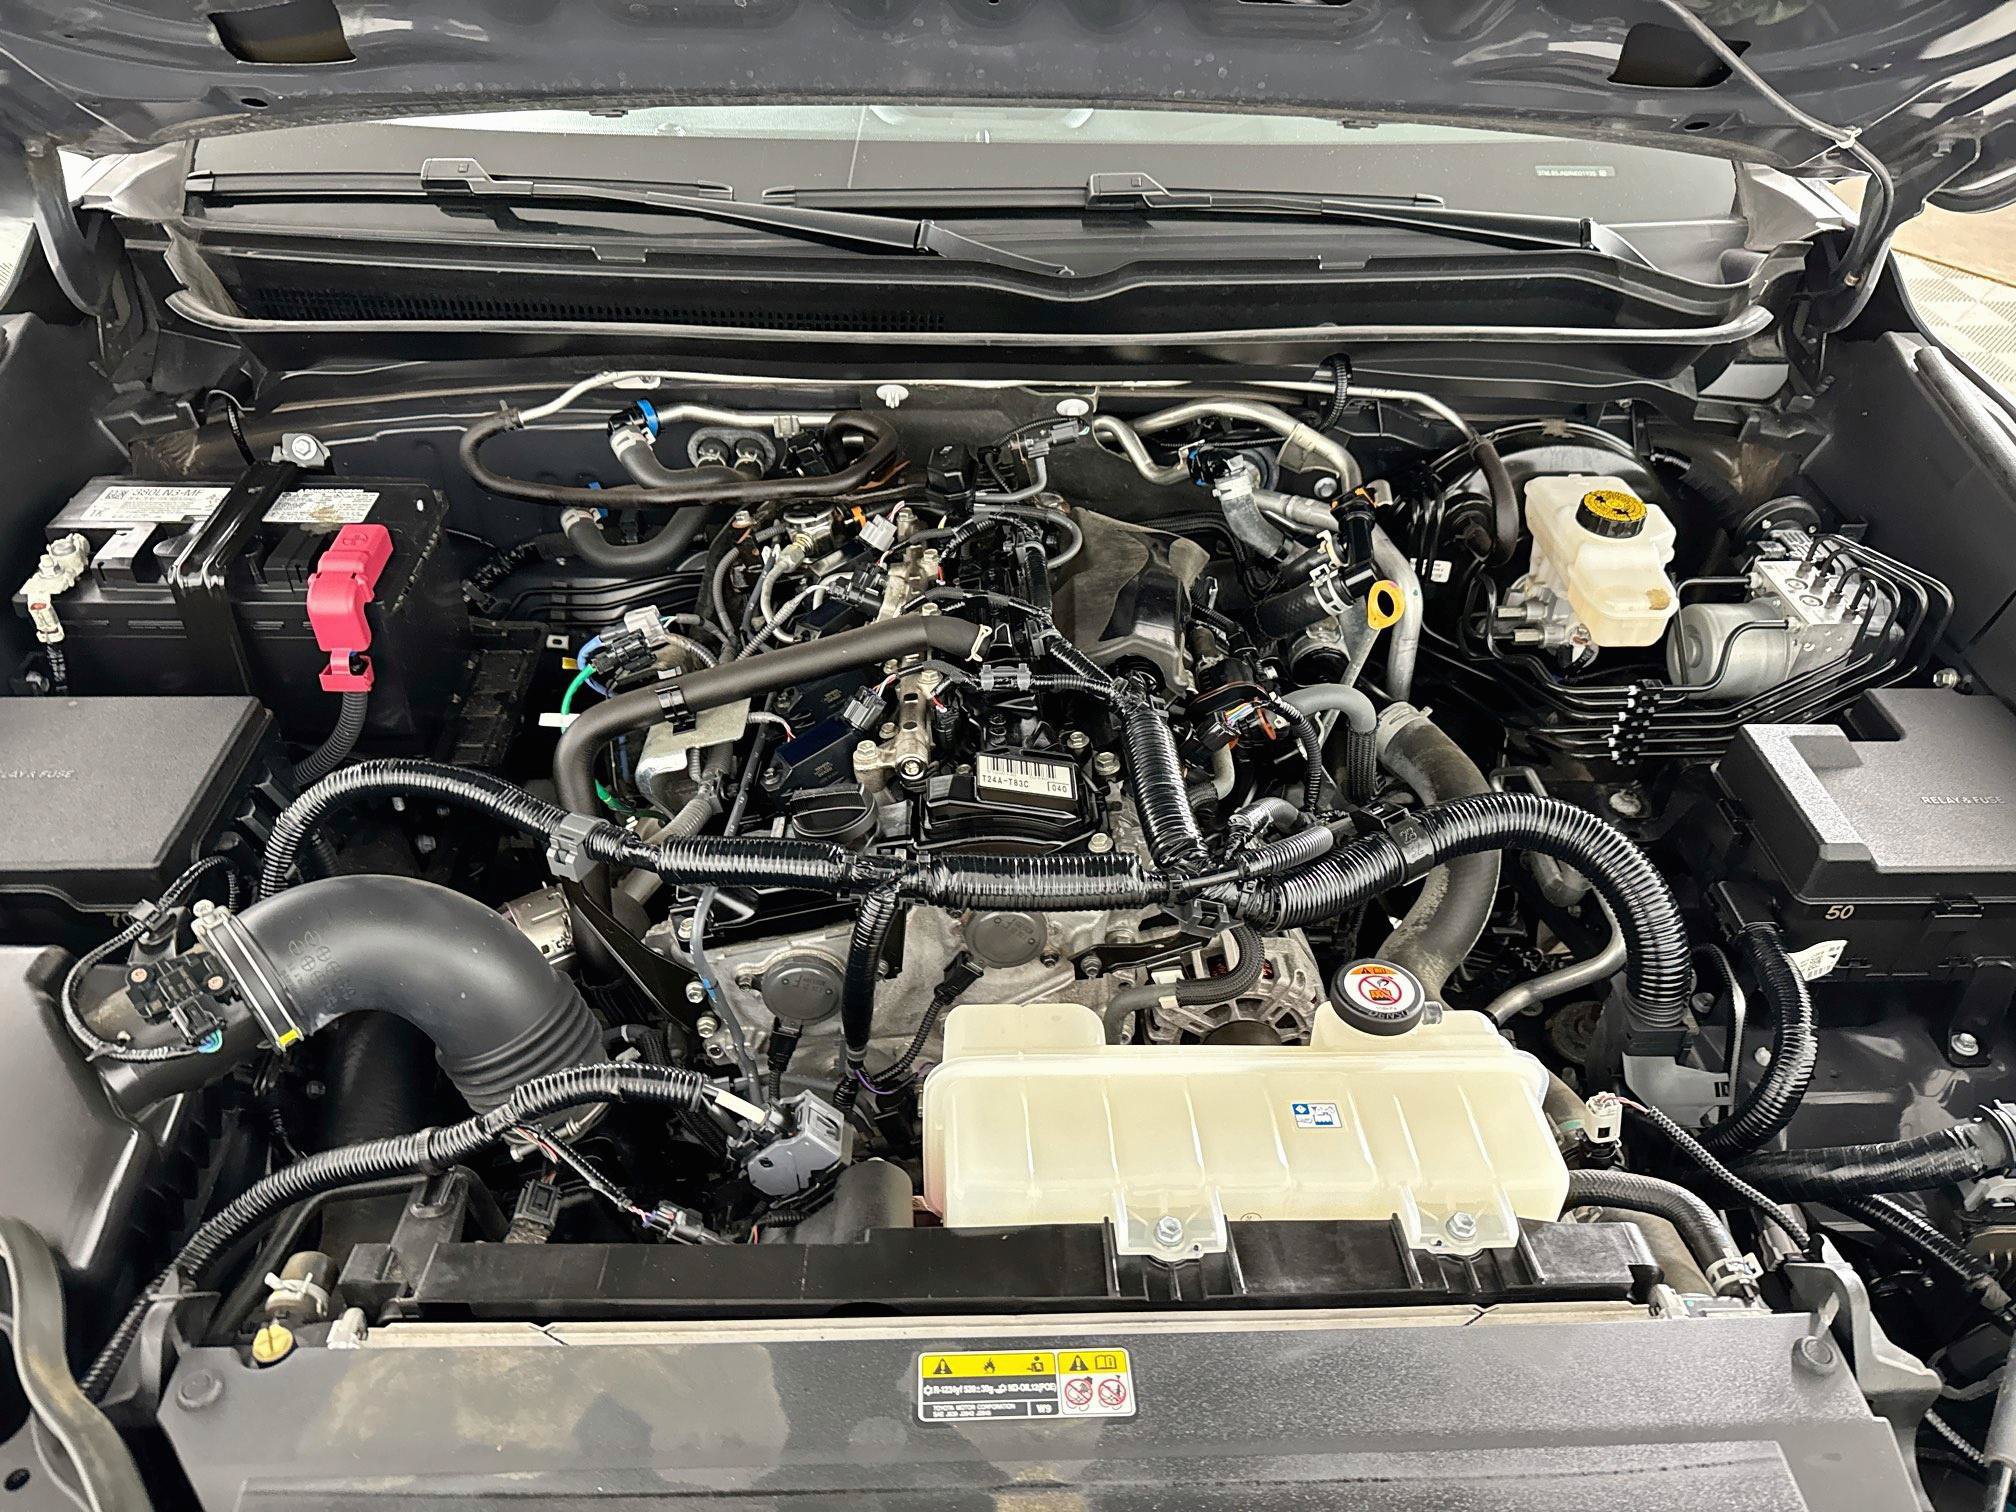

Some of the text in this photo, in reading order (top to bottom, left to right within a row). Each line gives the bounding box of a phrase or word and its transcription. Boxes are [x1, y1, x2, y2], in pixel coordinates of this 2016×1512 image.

[982, 774, 1029, 789] T24A-T83C
[1921, 796, 2005, 804] RELAY & FUSE
[1825, 904, 1855, 920] 50
